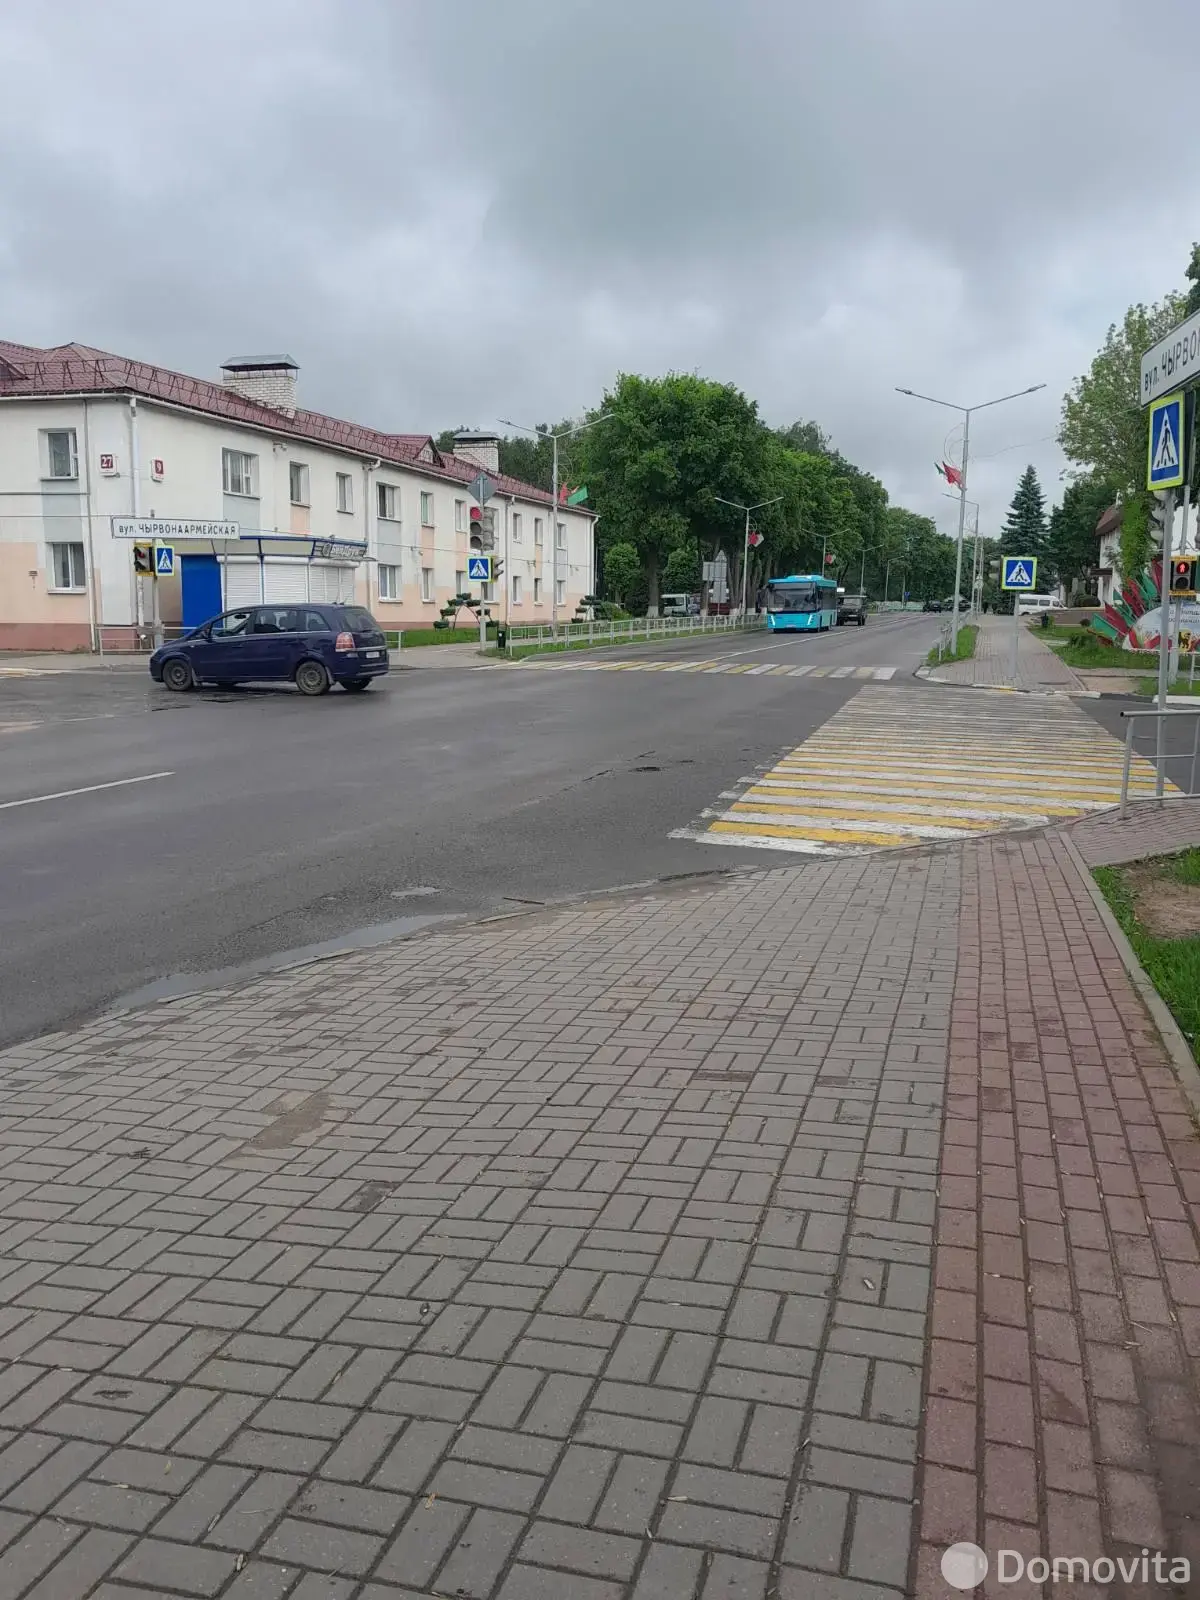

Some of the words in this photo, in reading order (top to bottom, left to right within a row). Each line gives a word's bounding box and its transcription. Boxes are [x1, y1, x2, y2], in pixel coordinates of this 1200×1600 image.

[1144, 366, 1160, 396] вул.
[101, 456, 112, 467] 27
[119, 524, 136, 535] вул.
[138, 523, 236, 536] ЧЫРВОНААРМЕЙСКАЯ
